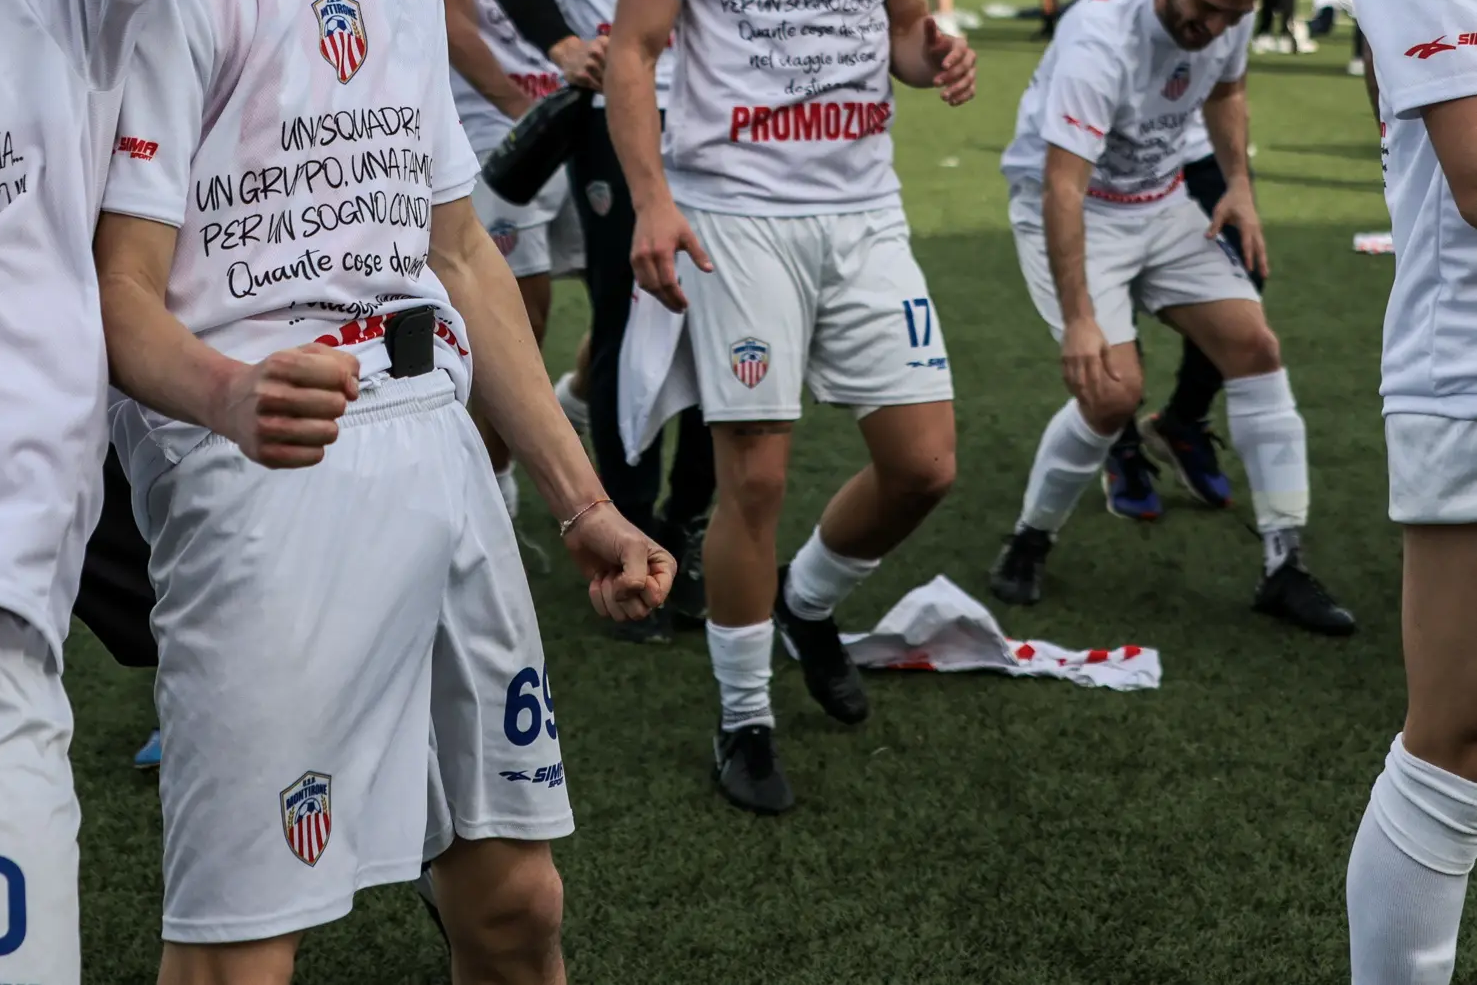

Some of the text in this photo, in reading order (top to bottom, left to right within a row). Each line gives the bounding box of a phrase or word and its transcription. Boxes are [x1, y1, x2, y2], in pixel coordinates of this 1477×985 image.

[738, 19, 796, 41] Quante
[749, 49, 773, 69] nel
[778, 52, 833, 74] viaggio
[118, 136, 159, 155] SIMA
[196, 175, 233, 212] UN
[352, 147, 400, 183] UNA
[200, 214, 263, 257] PER
[301, 190, 386, 238] SOGNO
[227, 248, 333, 298] Quante
[342, 251, 383, 277] cose
[902, 298, 931, 348] 17
